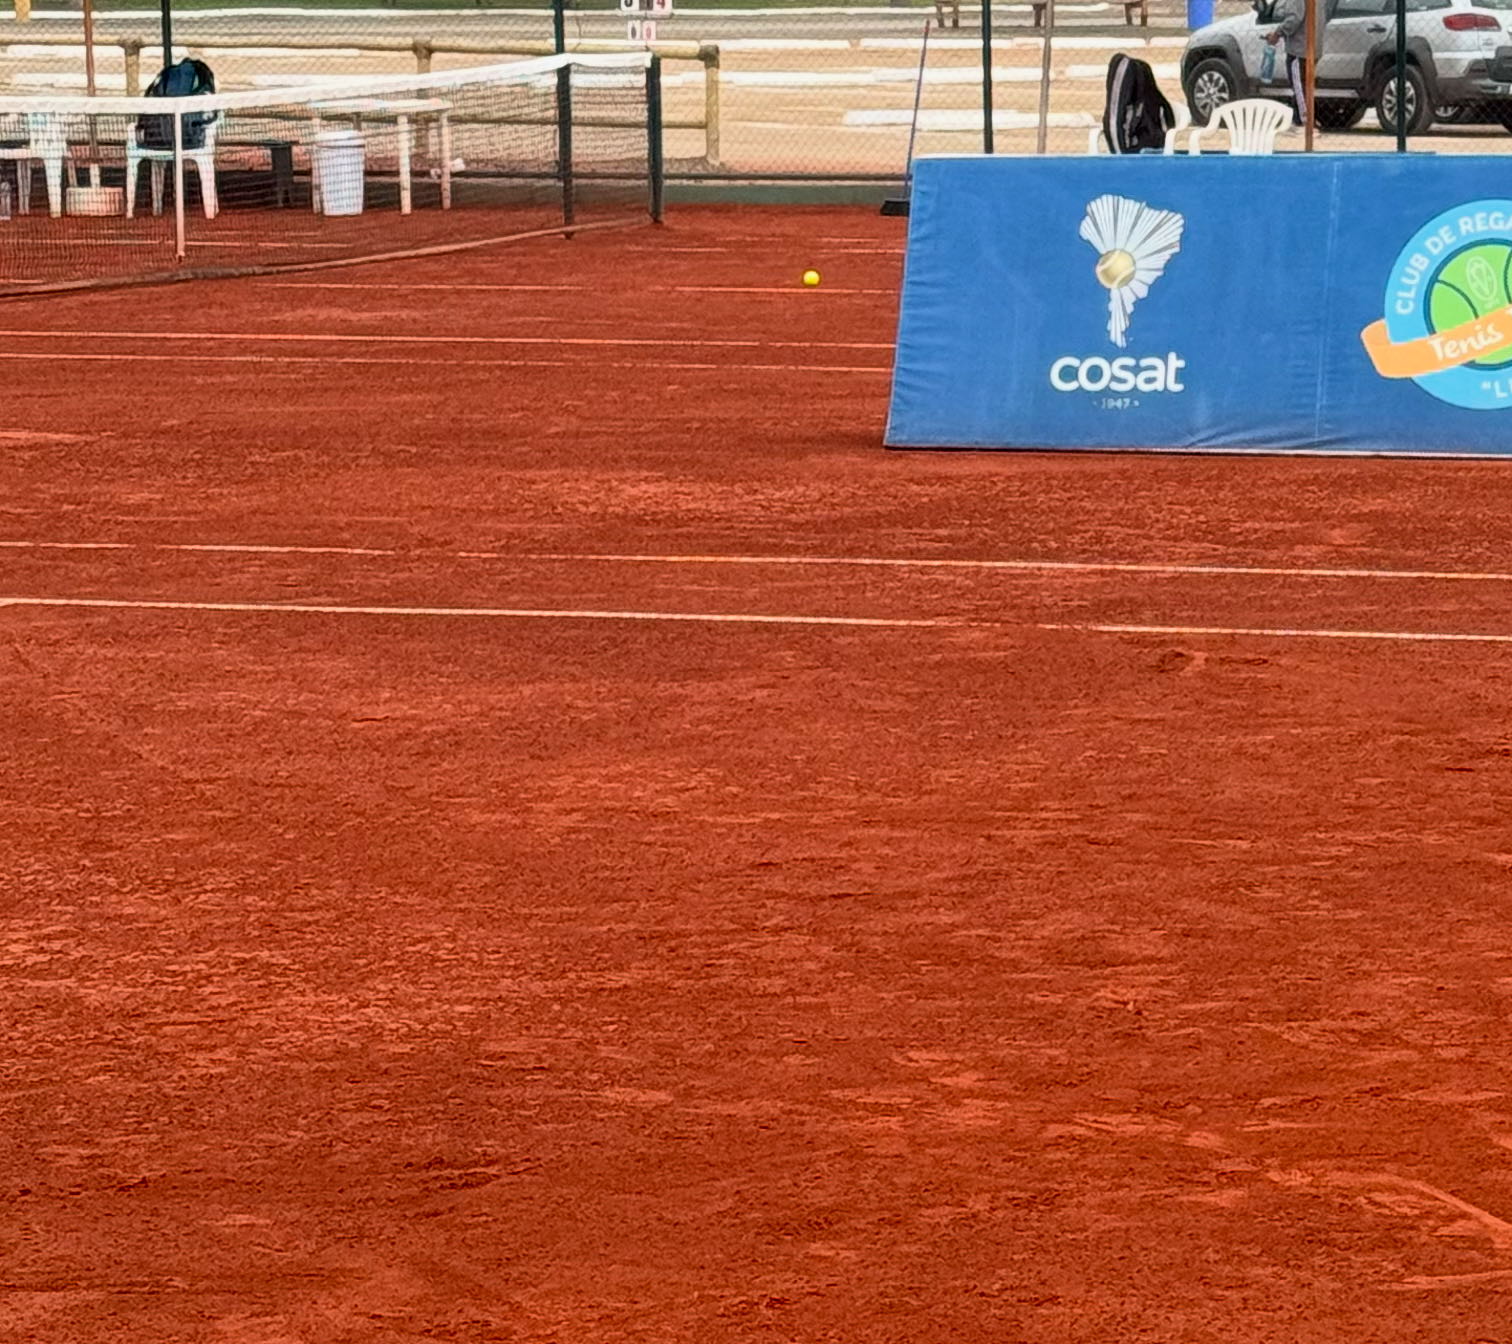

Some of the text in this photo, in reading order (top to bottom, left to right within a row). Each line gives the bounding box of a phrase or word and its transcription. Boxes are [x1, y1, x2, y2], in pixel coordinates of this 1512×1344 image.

[1396, 253, 1430, 315] CLUB
[1425, 225, 1457, 255] DE
[1428, 322, 1504, 361] Tenis
[1050, 351, 1186, 393] cosat
